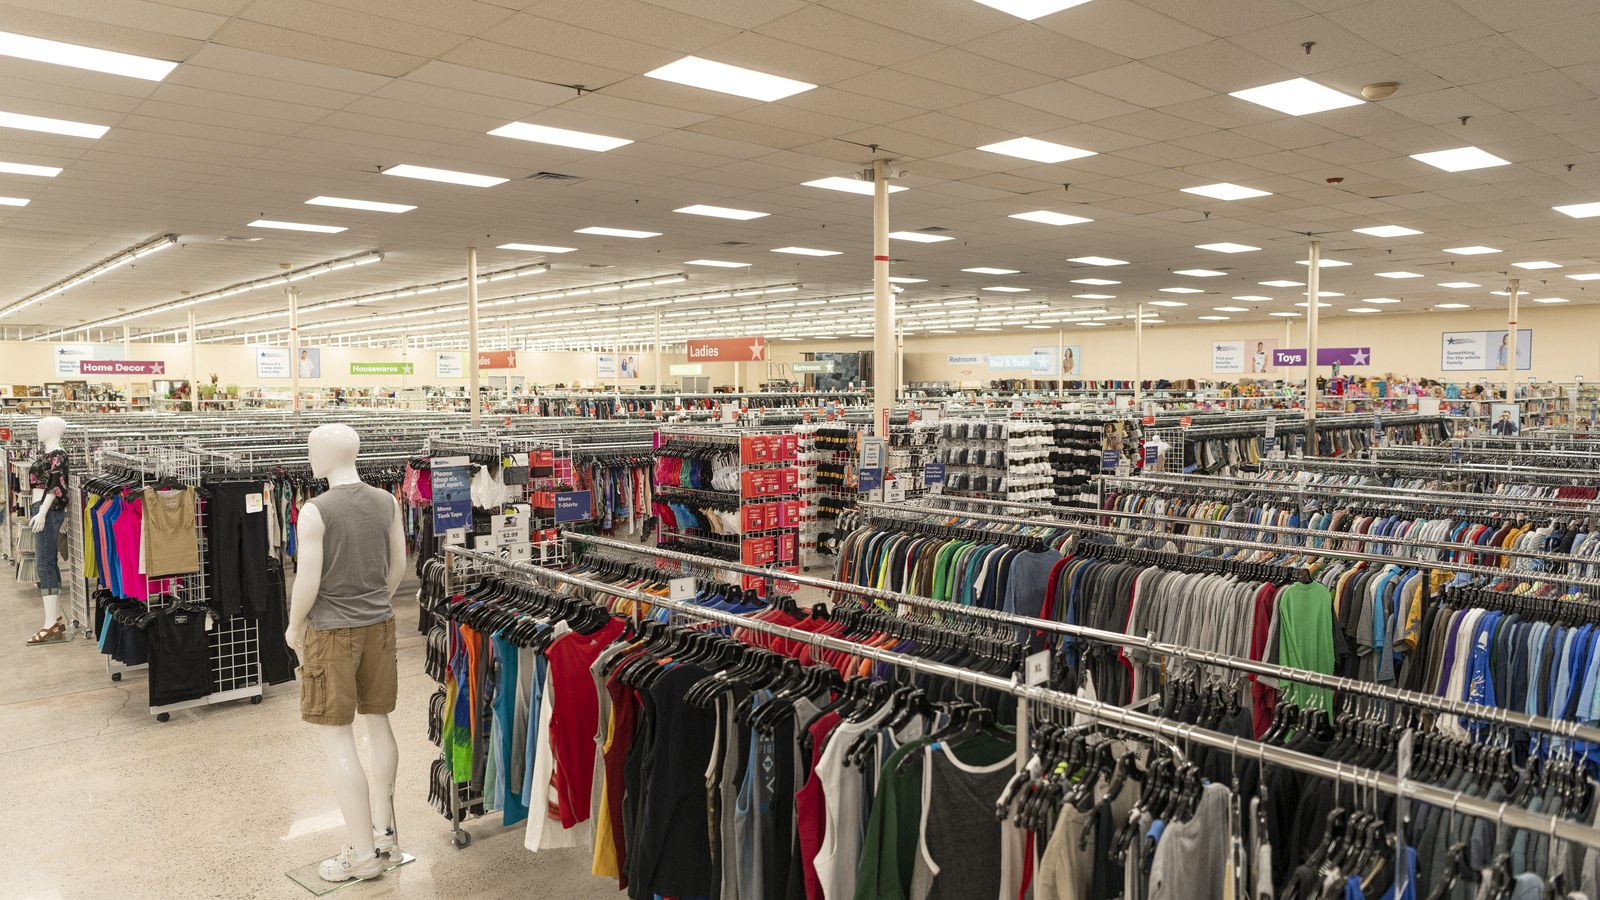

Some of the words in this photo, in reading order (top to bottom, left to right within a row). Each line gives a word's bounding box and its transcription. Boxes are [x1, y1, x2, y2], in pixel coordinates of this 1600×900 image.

[690, 345, 719, 357] Ladies
[479, 355, 490, 365] dies
[1277, 353, 1302, 363] Toys
[83, 363, 113, 372] Home
[115, 363, 145, 372] Decor
[1012, 359, 1030, 367] Bath
[352, 365, 398, 373] Housewares
[793, 364, 821, 372] Mattresses
[1034, 663, 1042, 673] XL
